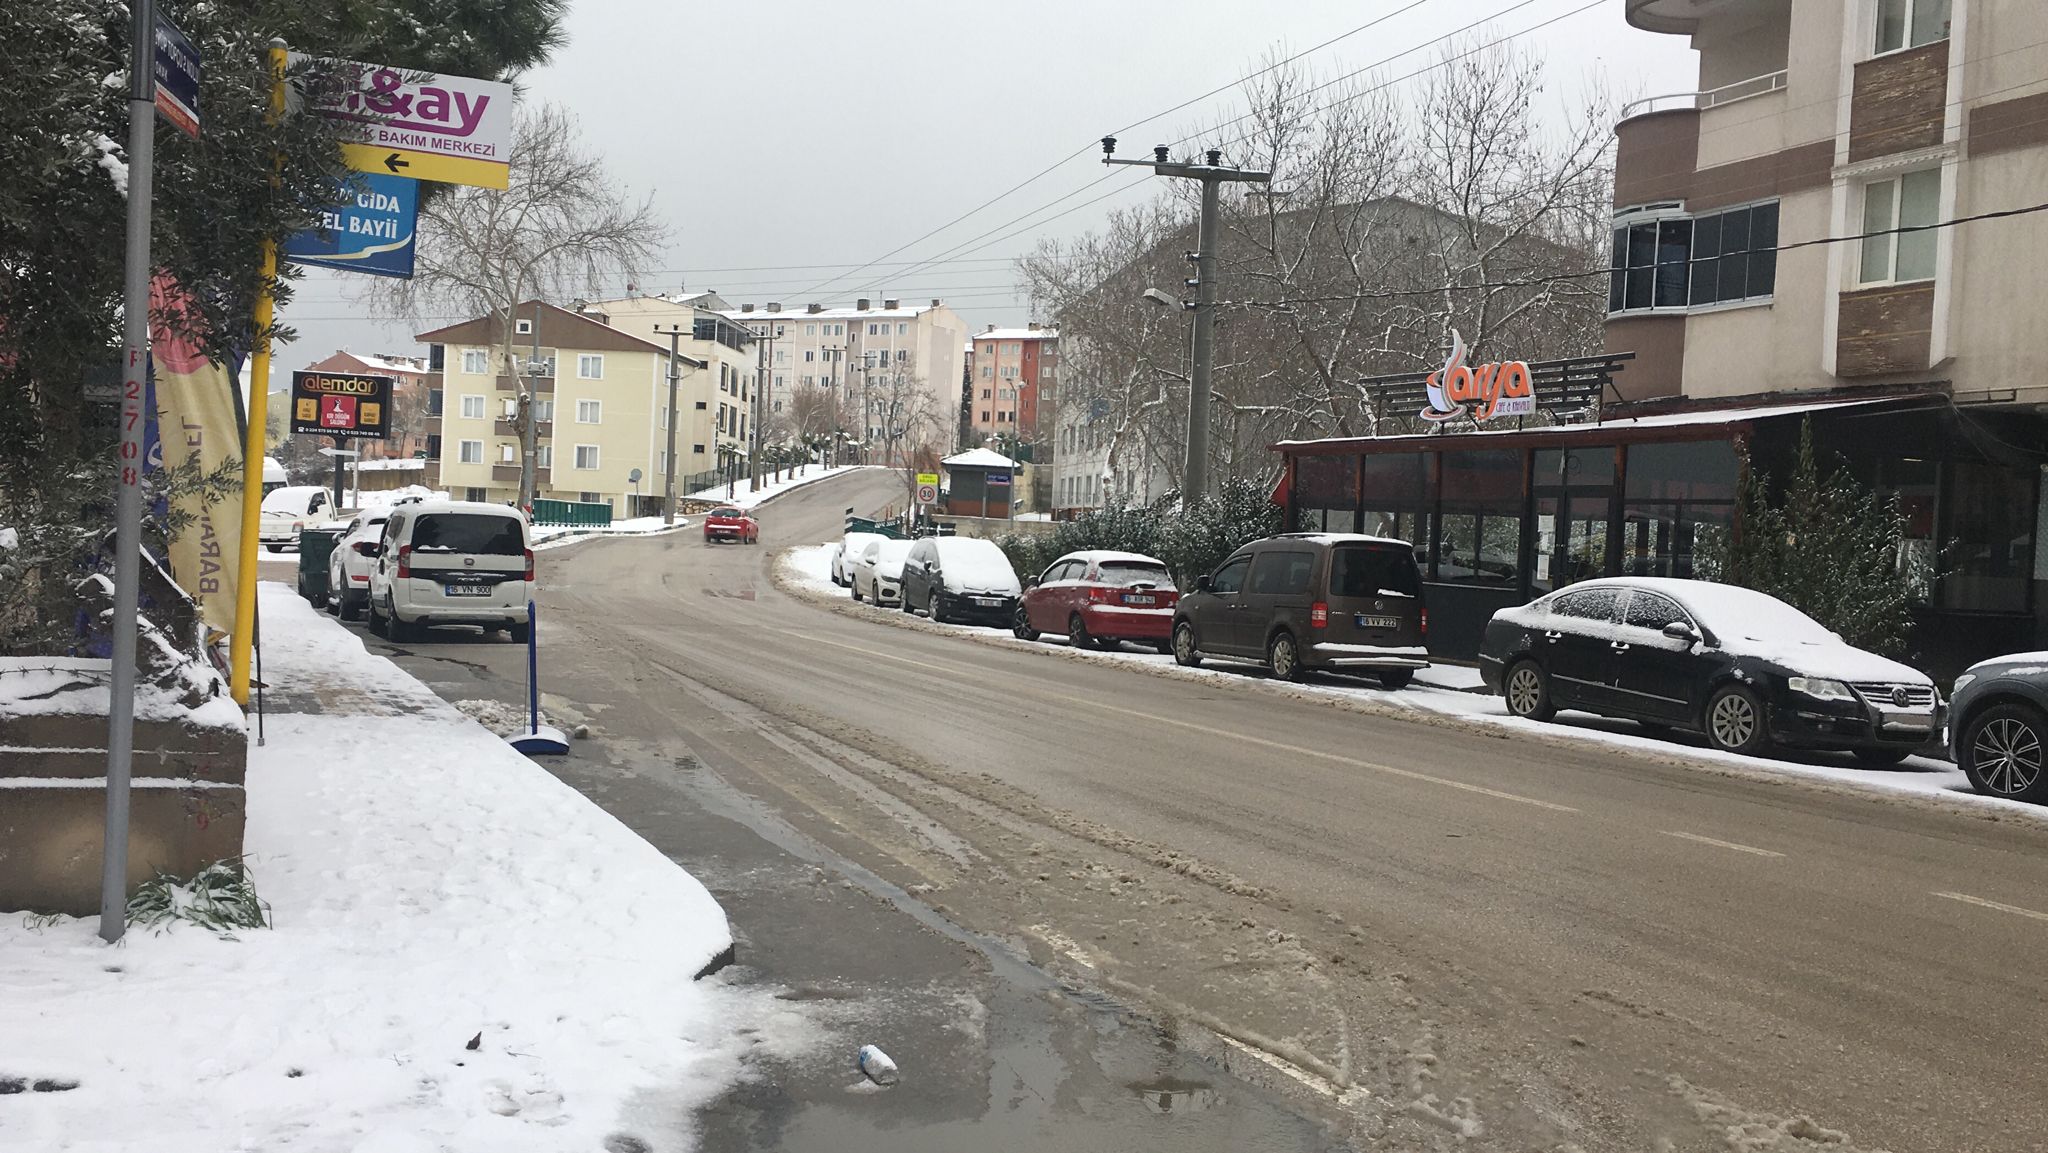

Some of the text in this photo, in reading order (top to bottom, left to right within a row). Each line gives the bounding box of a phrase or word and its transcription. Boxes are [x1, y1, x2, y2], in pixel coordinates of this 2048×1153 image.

[379, 131, 427, 148] BAKIM
[431, 138, 496, 157] MERKEZİ
[349, 215, 398, 240] BAYİİ
[305, 375, 373, 393] alemdar
[922, 489, 932, 498] 30
